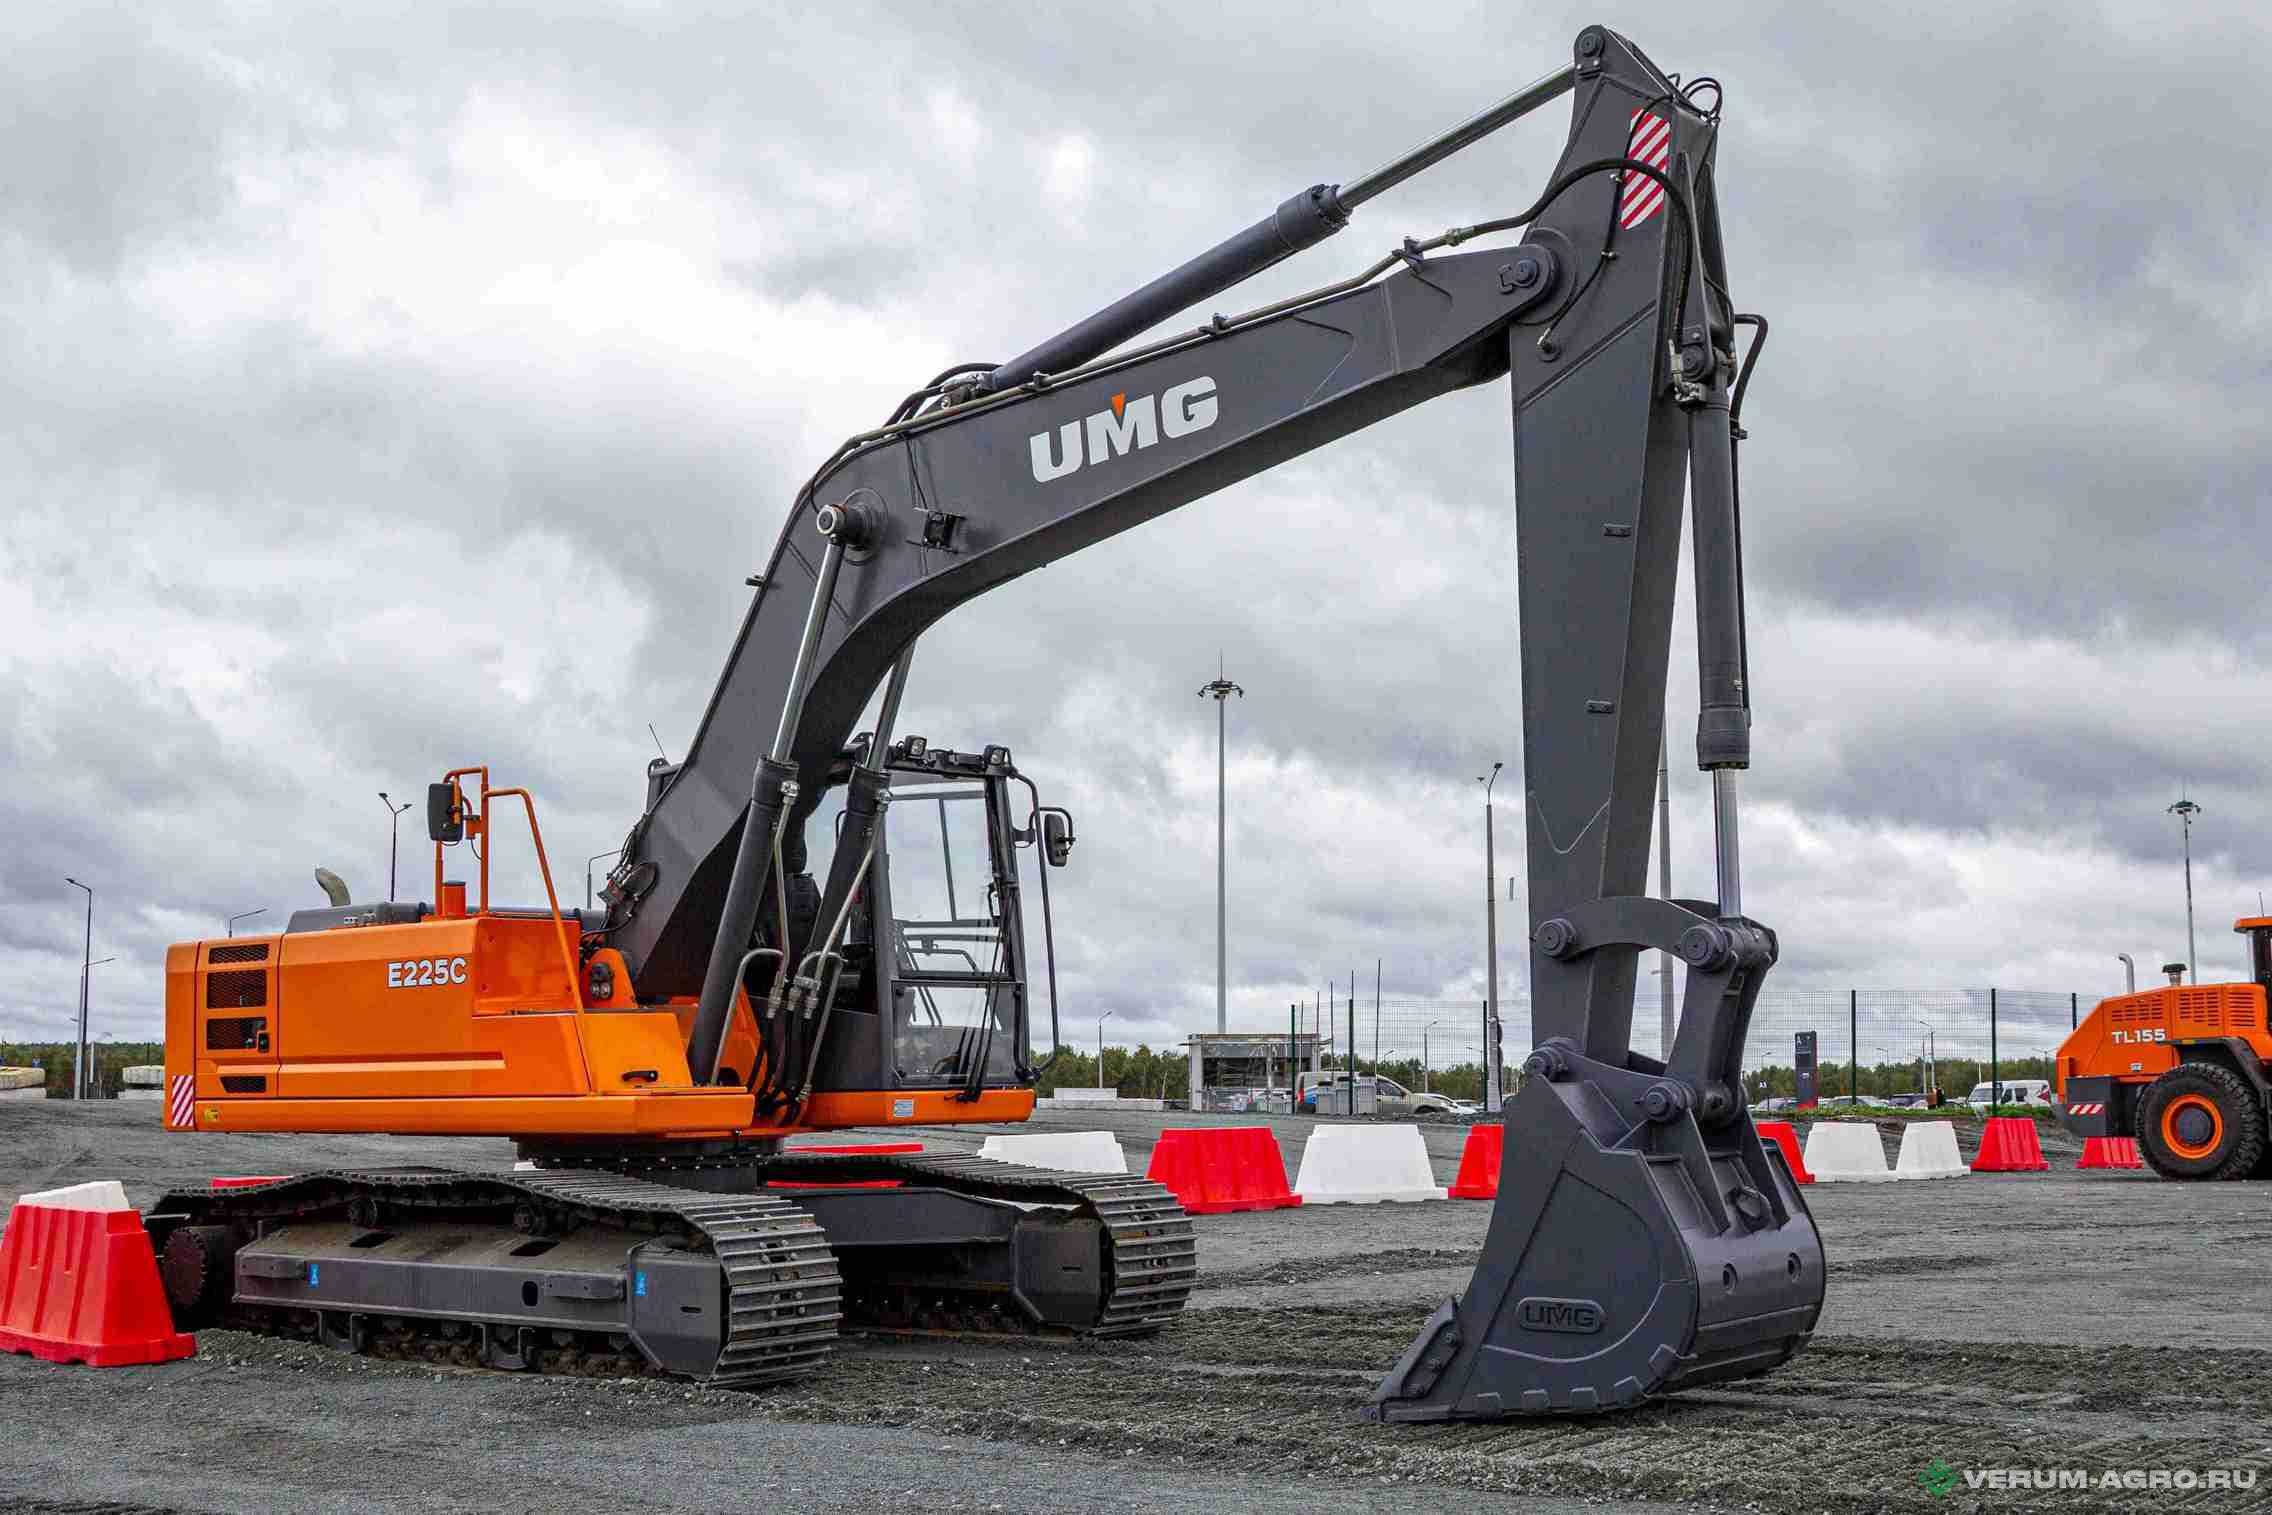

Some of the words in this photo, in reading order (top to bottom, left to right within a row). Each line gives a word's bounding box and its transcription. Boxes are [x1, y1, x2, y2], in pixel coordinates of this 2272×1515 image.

[1030, 376, 1218, 483] UMG
[387, 956, 467, 987] E225C
[2111, 1028, 2166, 1044] TL155
[1524, 1302, 1597, 1328] UMG
